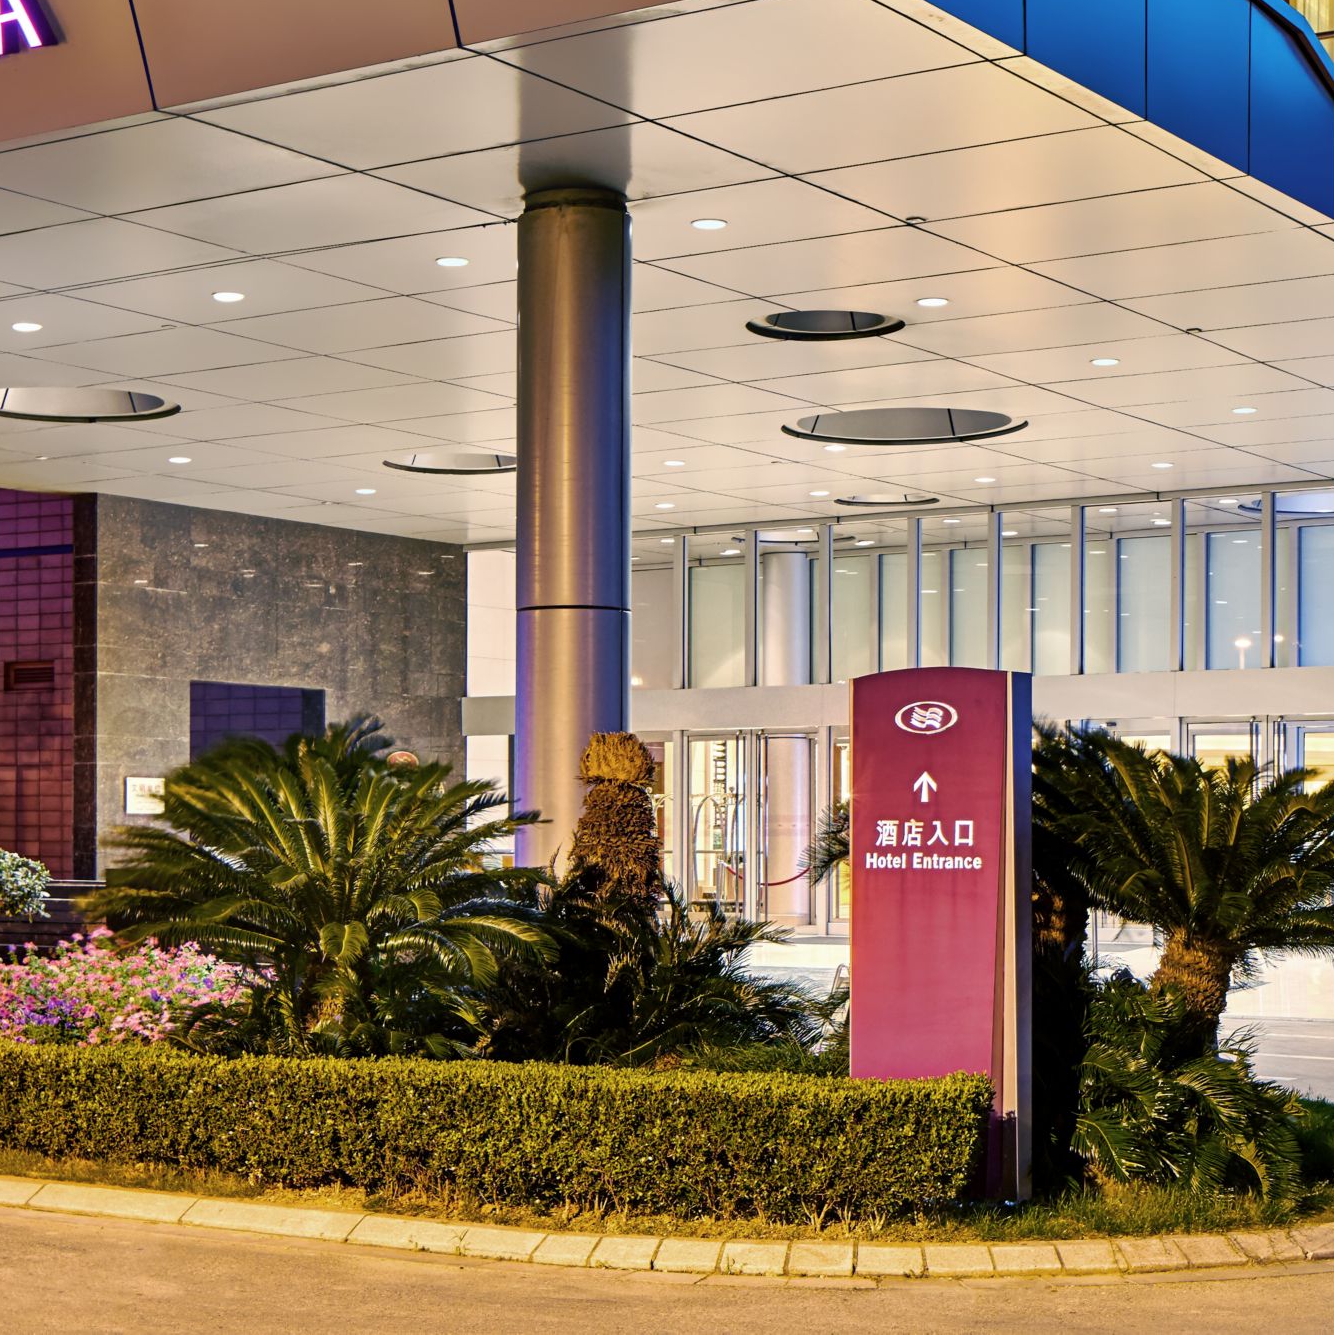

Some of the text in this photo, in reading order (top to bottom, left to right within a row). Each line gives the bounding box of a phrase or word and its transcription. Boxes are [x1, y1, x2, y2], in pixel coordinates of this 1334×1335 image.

[875, 819, 974, 847] 酒店入口
[865, 852, 983, 870] Hotel Entrance
